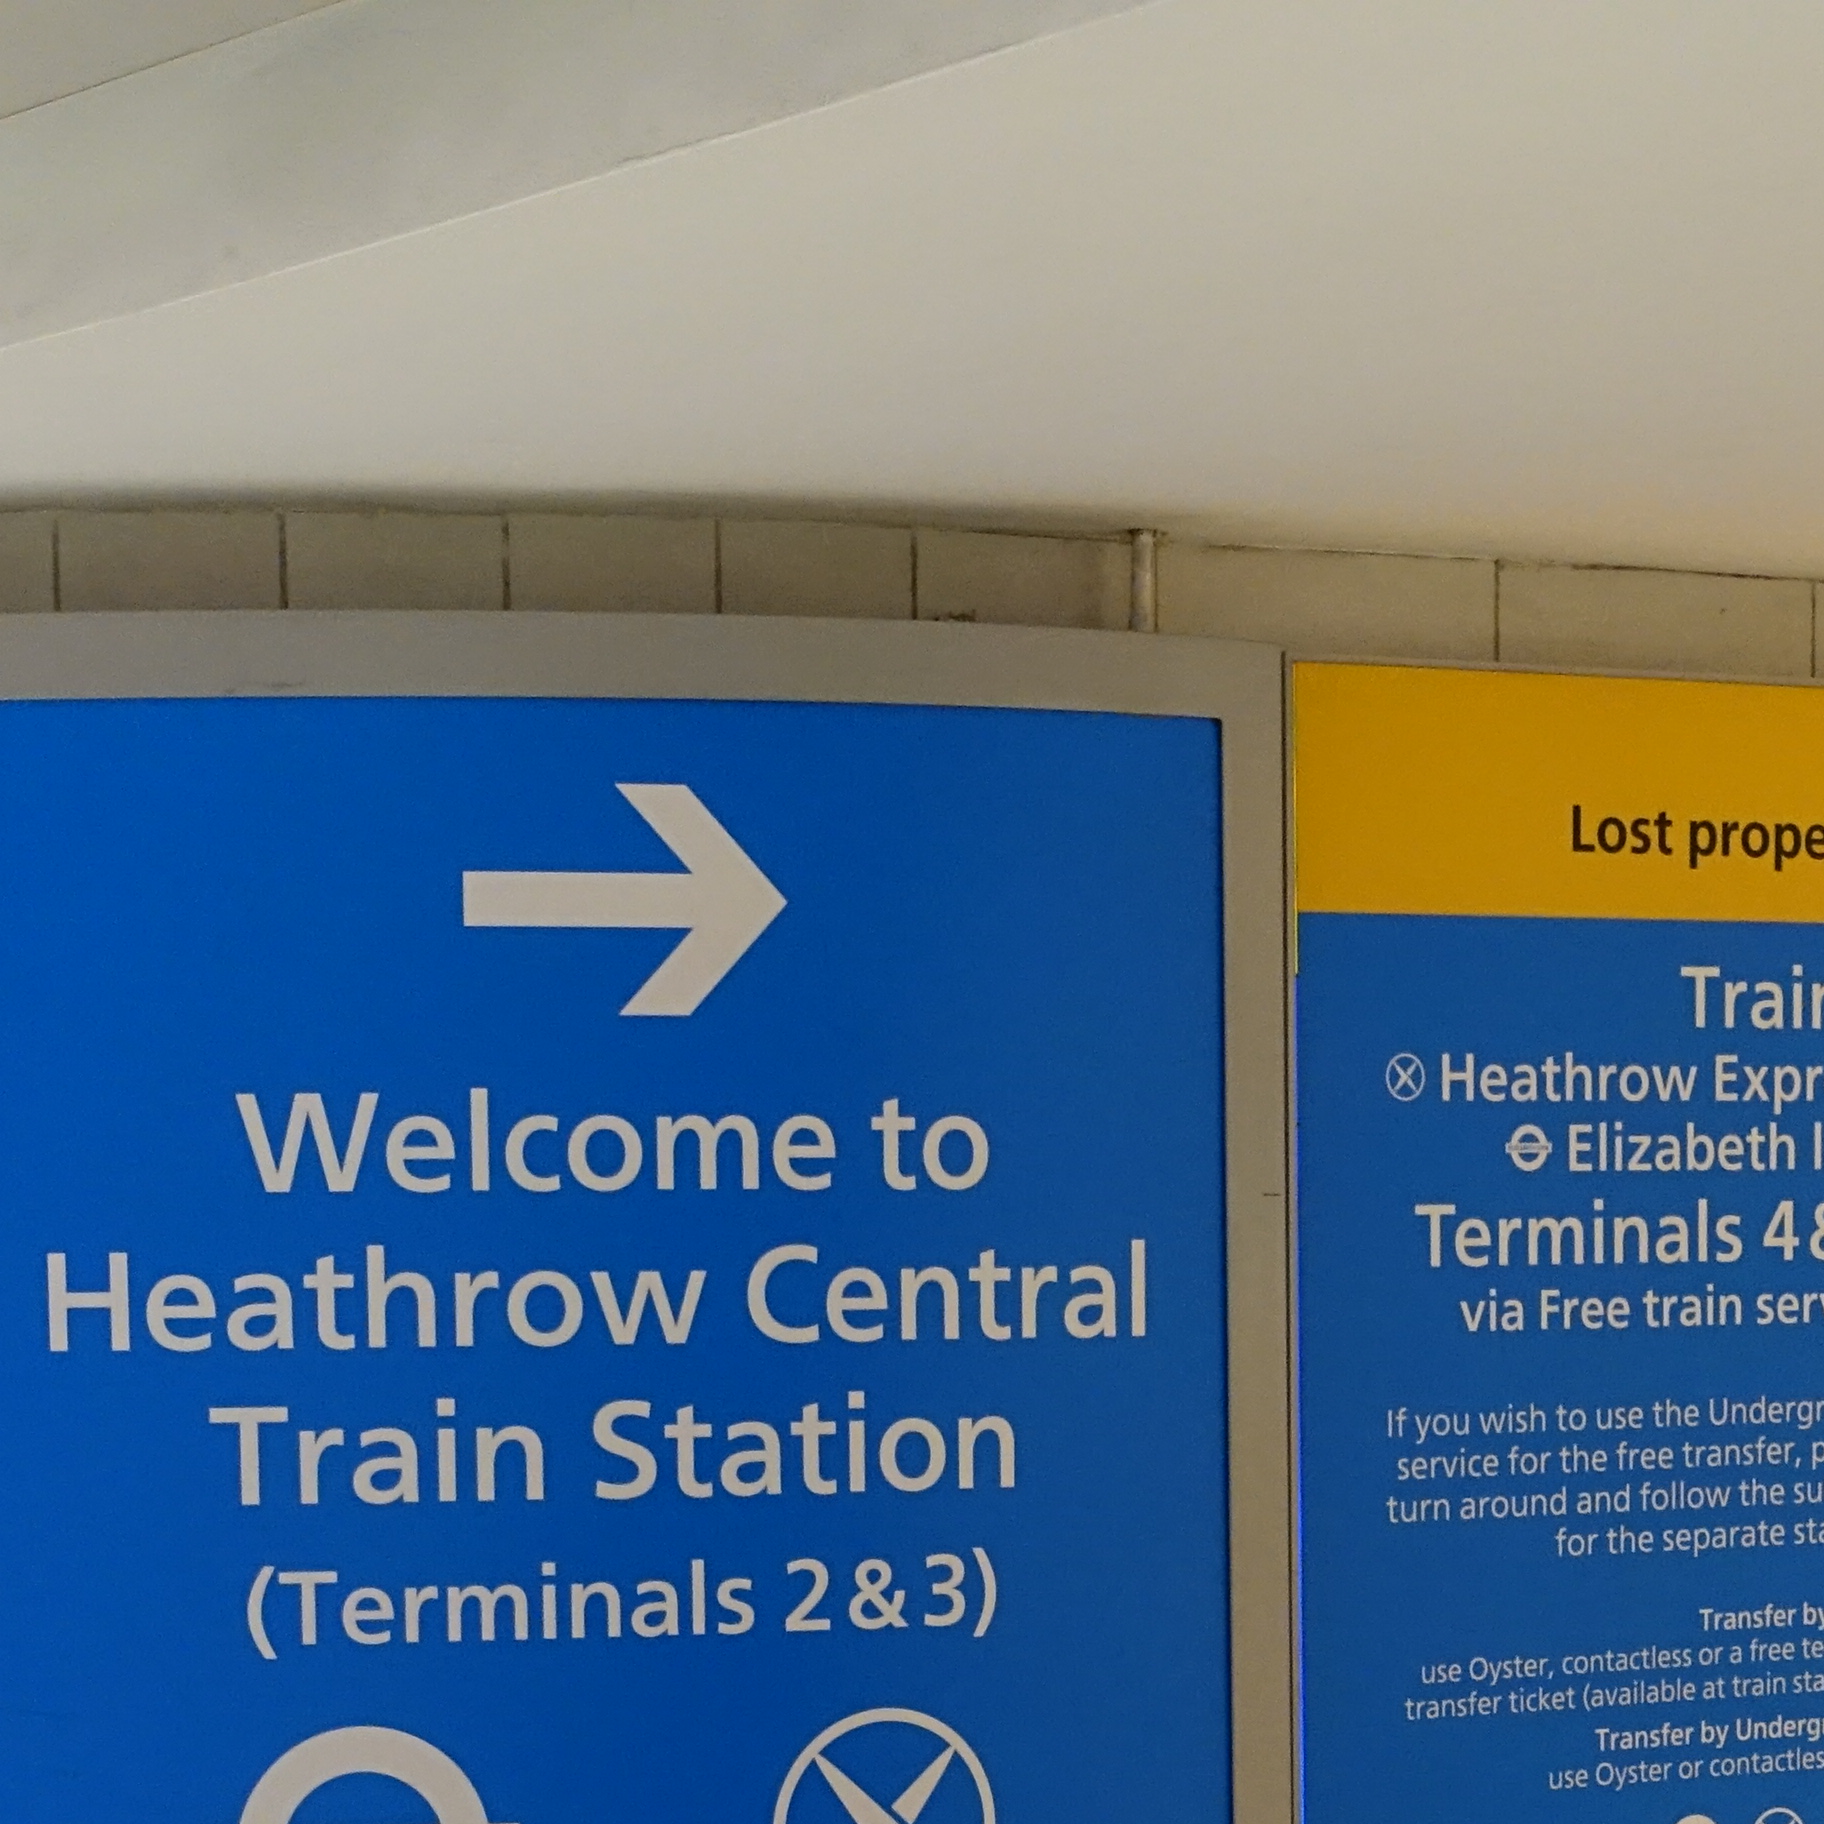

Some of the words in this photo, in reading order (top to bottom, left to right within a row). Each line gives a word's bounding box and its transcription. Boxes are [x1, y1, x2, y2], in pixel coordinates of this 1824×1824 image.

[1573, 805, 1672, 855] Lost
[1442, 1052, 1697, 1101] Heathrow
[236, 1088, 835, 1193] Welcome
[871, 1099, 988, 1190] to
[1569, 1122, 1795, 1171] Elizabeth
[1415, 1199, 1742, 1267] Terminals
[47, 1245, 706, 1352] Heathrow
[748, 1239, 1145, 1343] Central
[1461, 1300, 1523, 1331] via
[1541, 1290, 1630, 1329] Free
[1643, 1284, 1741, 1327] train
[1388, 1407, 1406, 1437] If
[1415, 1413, 1469, 1444] you
[1480, 1403, 1546, 1434] wish
[1556, 1405, 1586, 1431] to
[1597, 1407, 1643, 1430] use
[1652, 1399, 1699, 1427] the
[209, 1398, 543, 1505] Train
[593, 1391, 1015, 1499] Station
[1398, 1448, 1499, 1480] service
[1508, 1446, 1551, 1475] for
[1559, 1444, 1607, 1473] the
[1616, 1441, 1673, 1470] free
[1682, 1436, 1801, 1468] transfer,
[1386, 1497, 1450, 1523] turn
[1460, 1486, 1566, 1519] around
[1577, 1484, 1630, 1514] and
[1640, 1481, 1730, 1511] follow
[1739, 1478, 1785, 1506] the
[1555, 1527, 1598, 1556] for
[1607, 1525, 1653, 1554] the
[1663, 1521, 1785, 1557] separate
[247, 1559, 754, 1659] (Terminals
[1699, 1604, 1796, 1631] Transfer
[1422, 1664, 1461, 1684] use
[1469, 1656, 1553, 1685] Oyster,
[1562, 1646, 1692, 1674] contactless
[1699, 1647, 1723, 1665] or
[1730, 1646, 1742, 1664] a
[1750, 1638, 1795, 1661] free
[1405, 1691, 1502, 1720] transfer
[1509, 1687, 1575, 1713] ticket
[1583, 1678, 1696, 1711] (available
[1703, 1678, 1725, 1699] at
[1732, 1672, 1786, 1697] train
[1595, 1722, 1694, 1751] Transfer
[1701, 1721, 1729, 1748] by
[1550, 1769, 1588, 1789] use
[1596, 1761, 1672, 1791] Oyster
[1679, 1760, 1703, 1779] or
